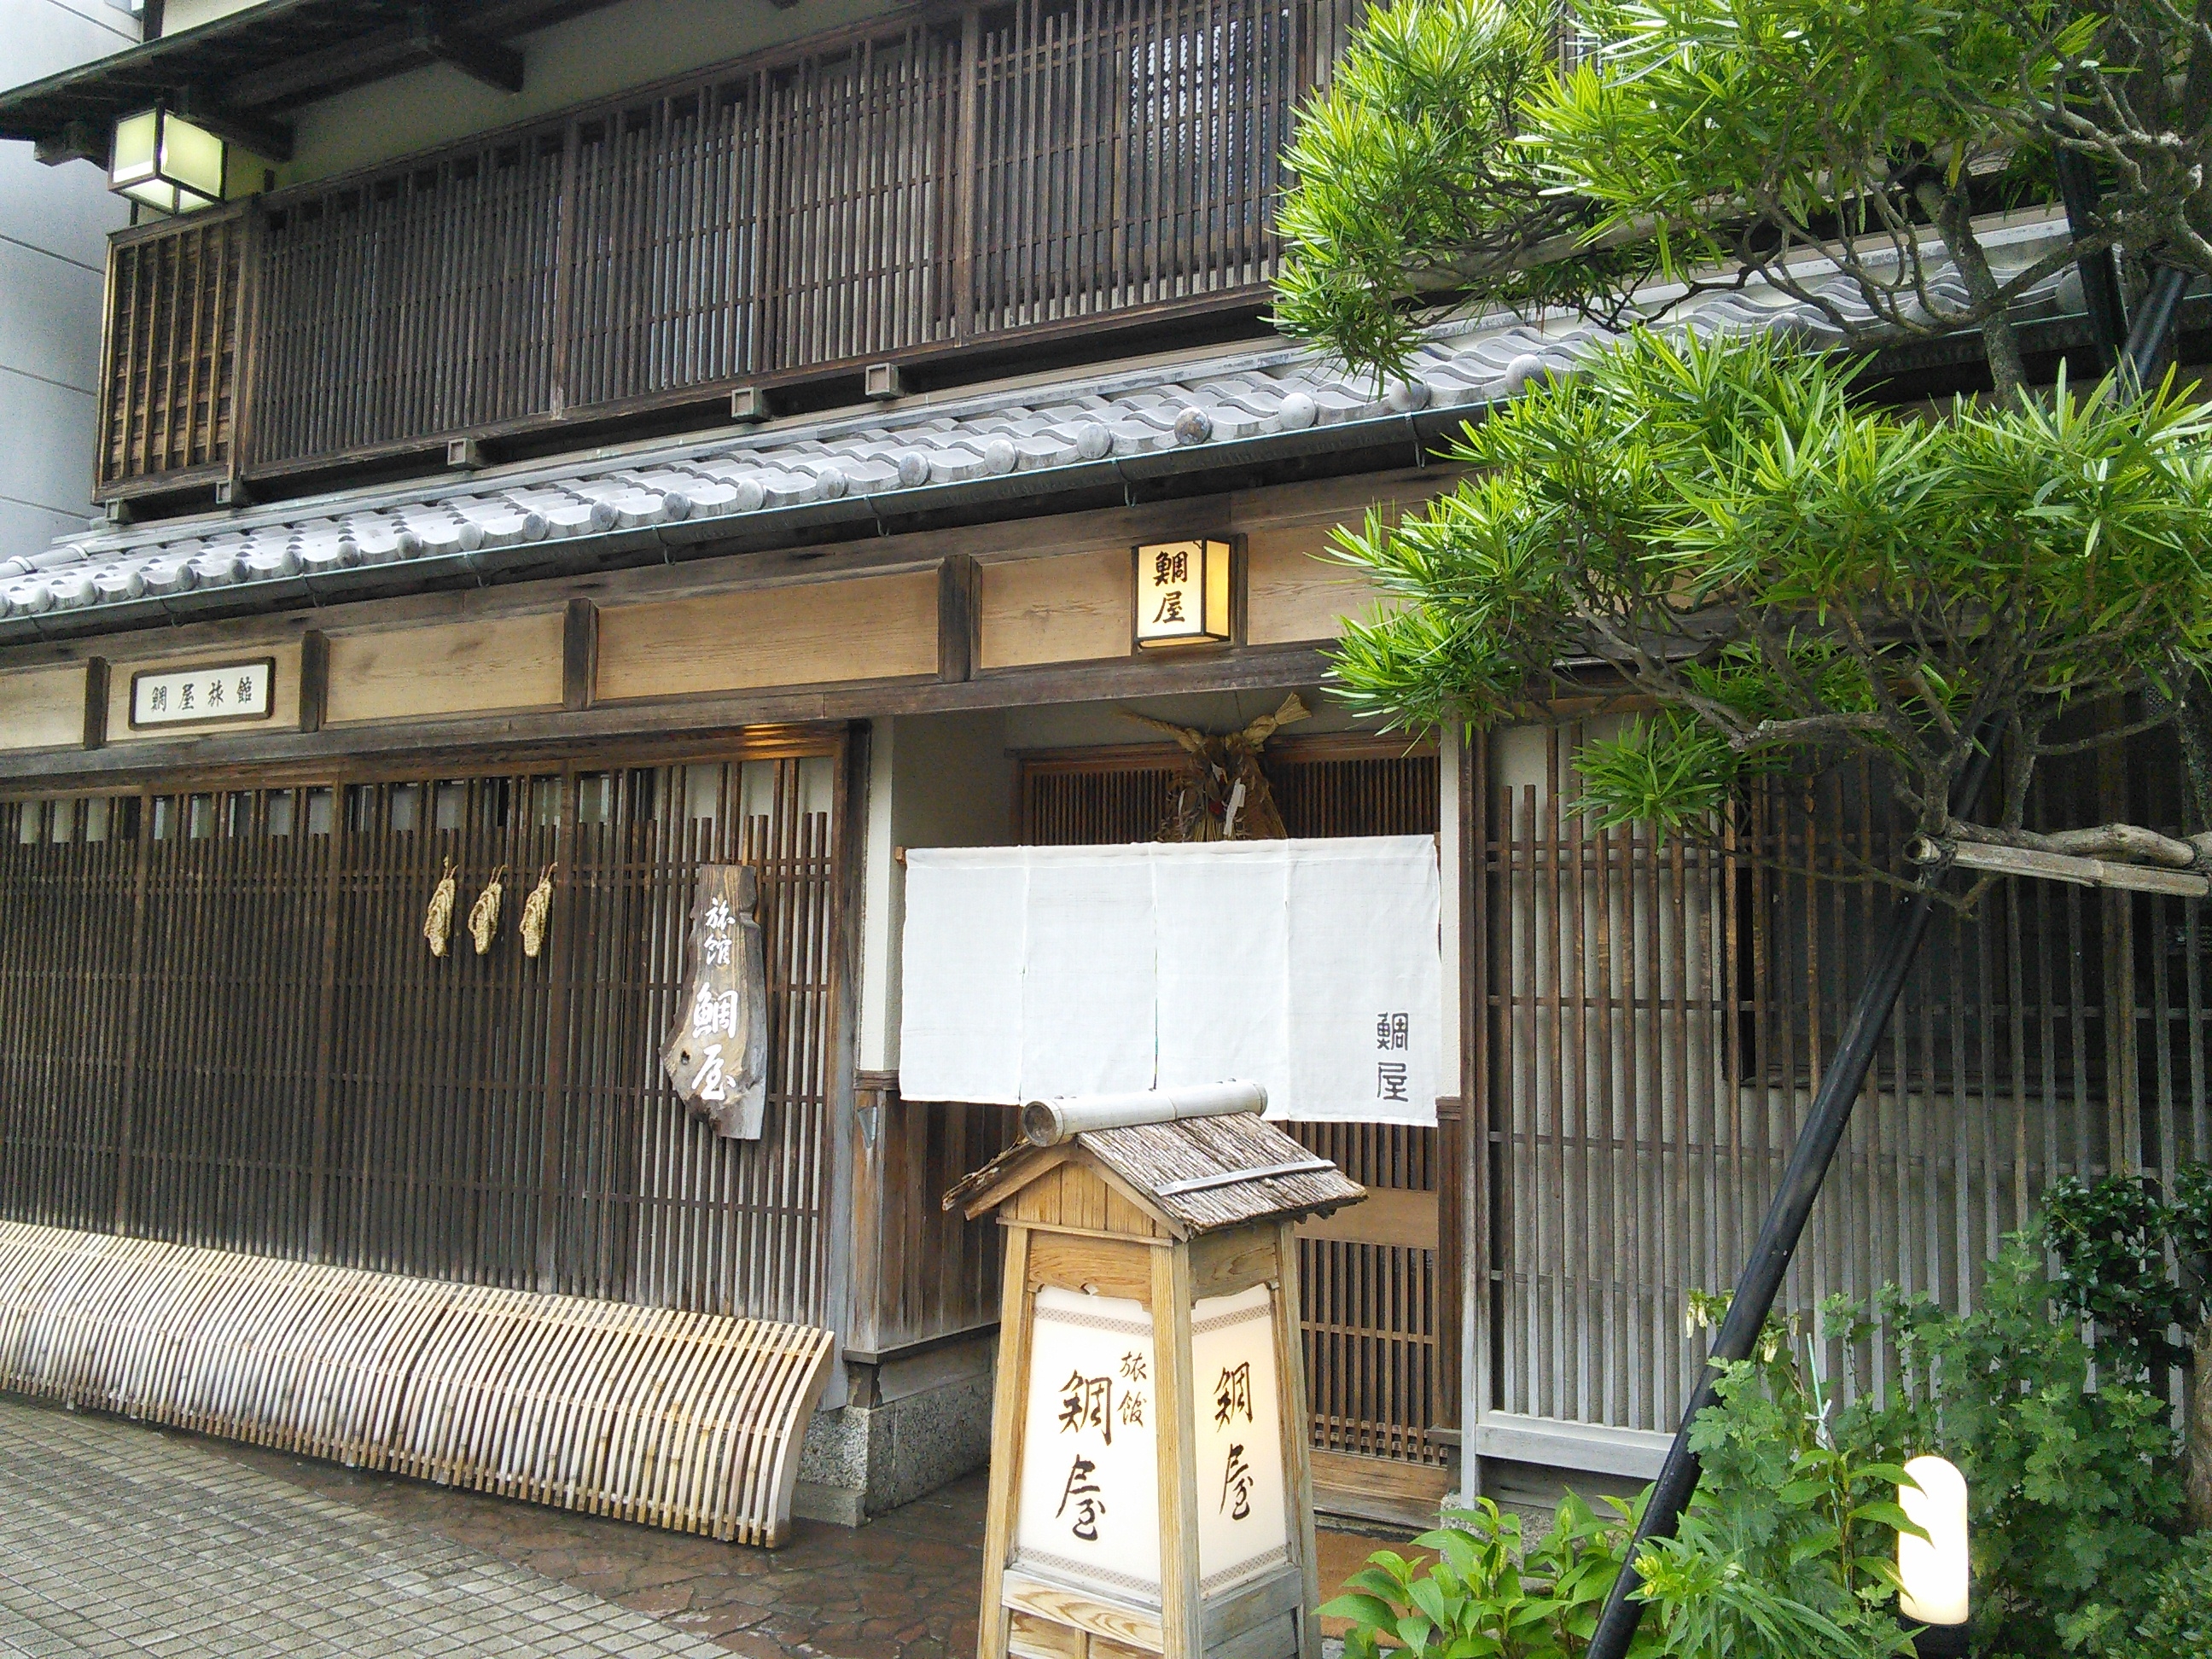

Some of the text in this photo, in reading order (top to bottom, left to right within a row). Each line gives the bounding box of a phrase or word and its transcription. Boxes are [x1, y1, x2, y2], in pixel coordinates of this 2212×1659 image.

[1152, 550, 1188, 624] 鯛屋
[691, 897, 739, 1101] 旅館 鯛屋
[1377, 1011, 1409, 1103] 鯛屋
[1055, 1369, 1113, 1541] 鯛屋
[1213, 1361, 1254, 1521] 鯛屋
